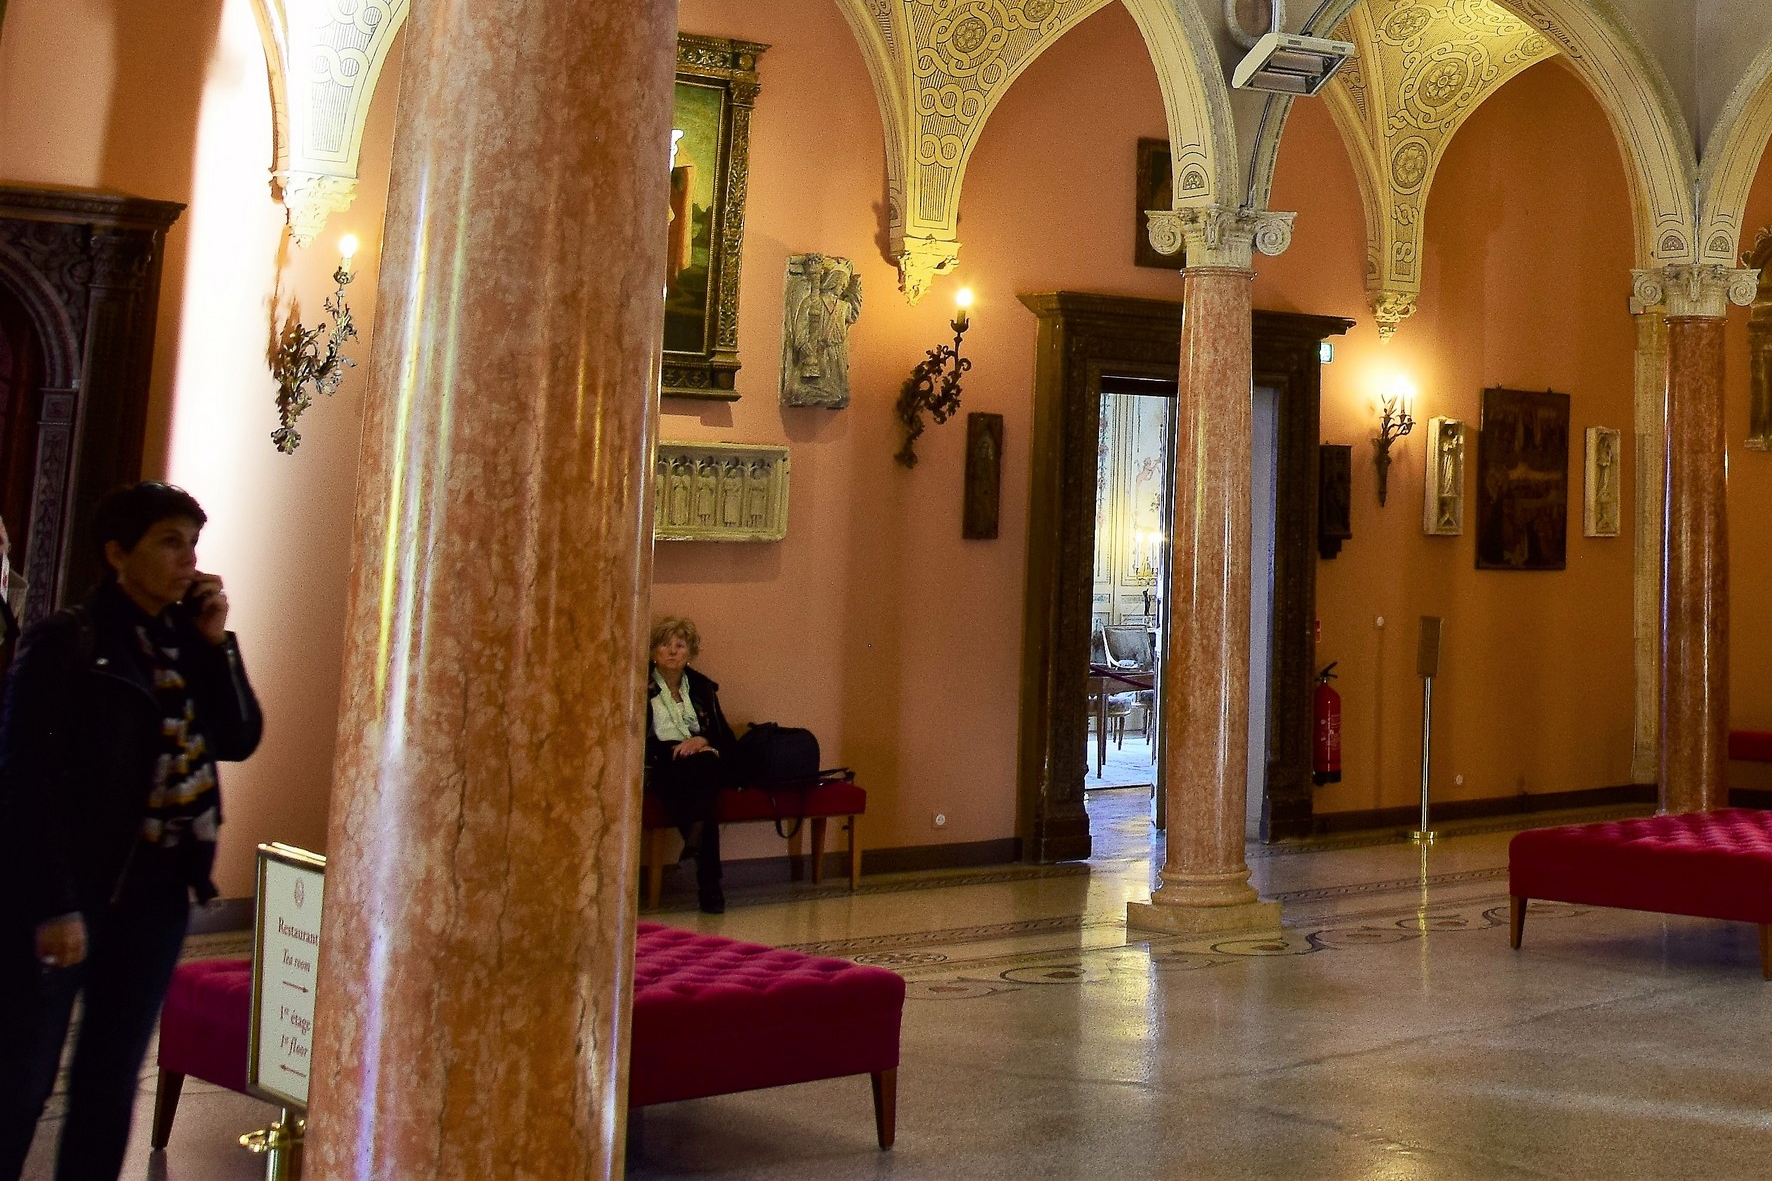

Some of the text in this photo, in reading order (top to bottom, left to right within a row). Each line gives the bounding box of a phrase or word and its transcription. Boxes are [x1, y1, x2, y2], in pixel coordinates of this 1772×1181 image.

[278, 916, 319, 946] Restaurant
[283, 948, 311, 972] Tea room
[290, 1009, 311, 1035] étage
[287, 1036, 309, 1057] floor
